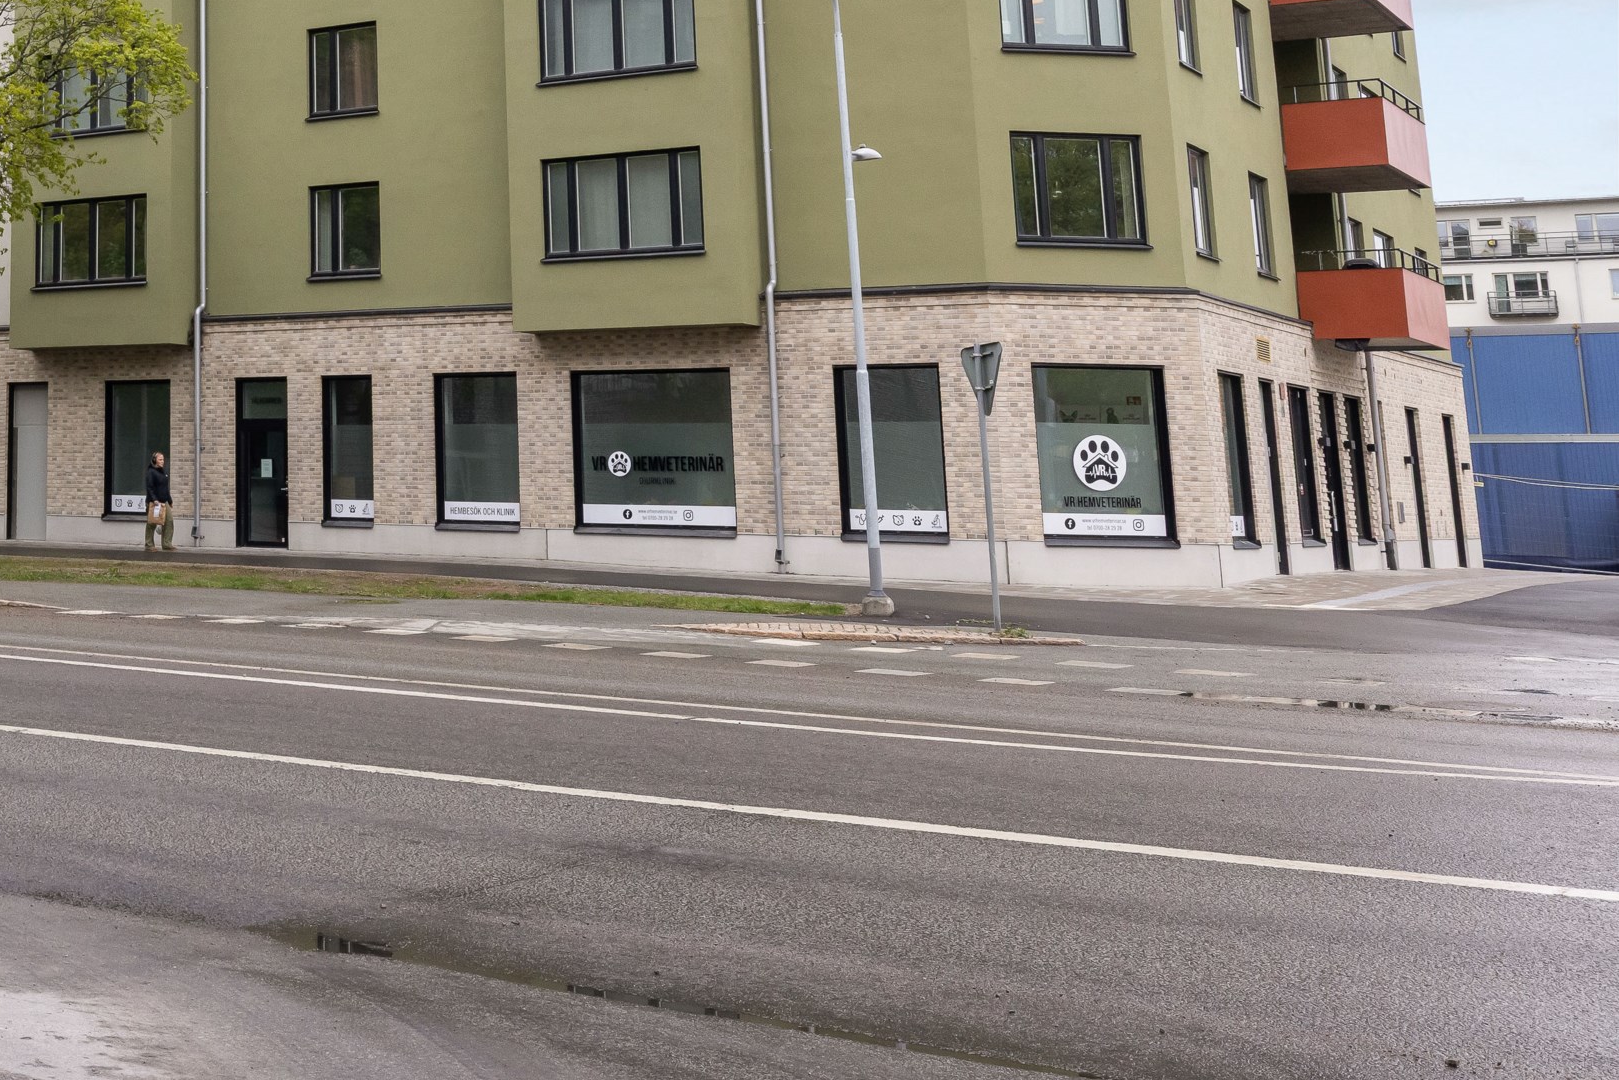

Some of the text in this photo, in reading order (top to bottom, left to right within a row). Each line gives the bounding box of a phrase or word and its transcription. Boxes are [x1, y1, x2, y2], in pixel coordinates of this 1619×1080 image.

[592, 456, 607, 471] VR
[633, 454, 724, 472] HEMVETERINÄR
[1095, 464, 1105, 476] VR
[1064, 496, 1142, 508] VR HEMVETERINÄR
[450, 506, 481, 515] HEMBESÖK
[497, 508, 515, 516] KLINIK
